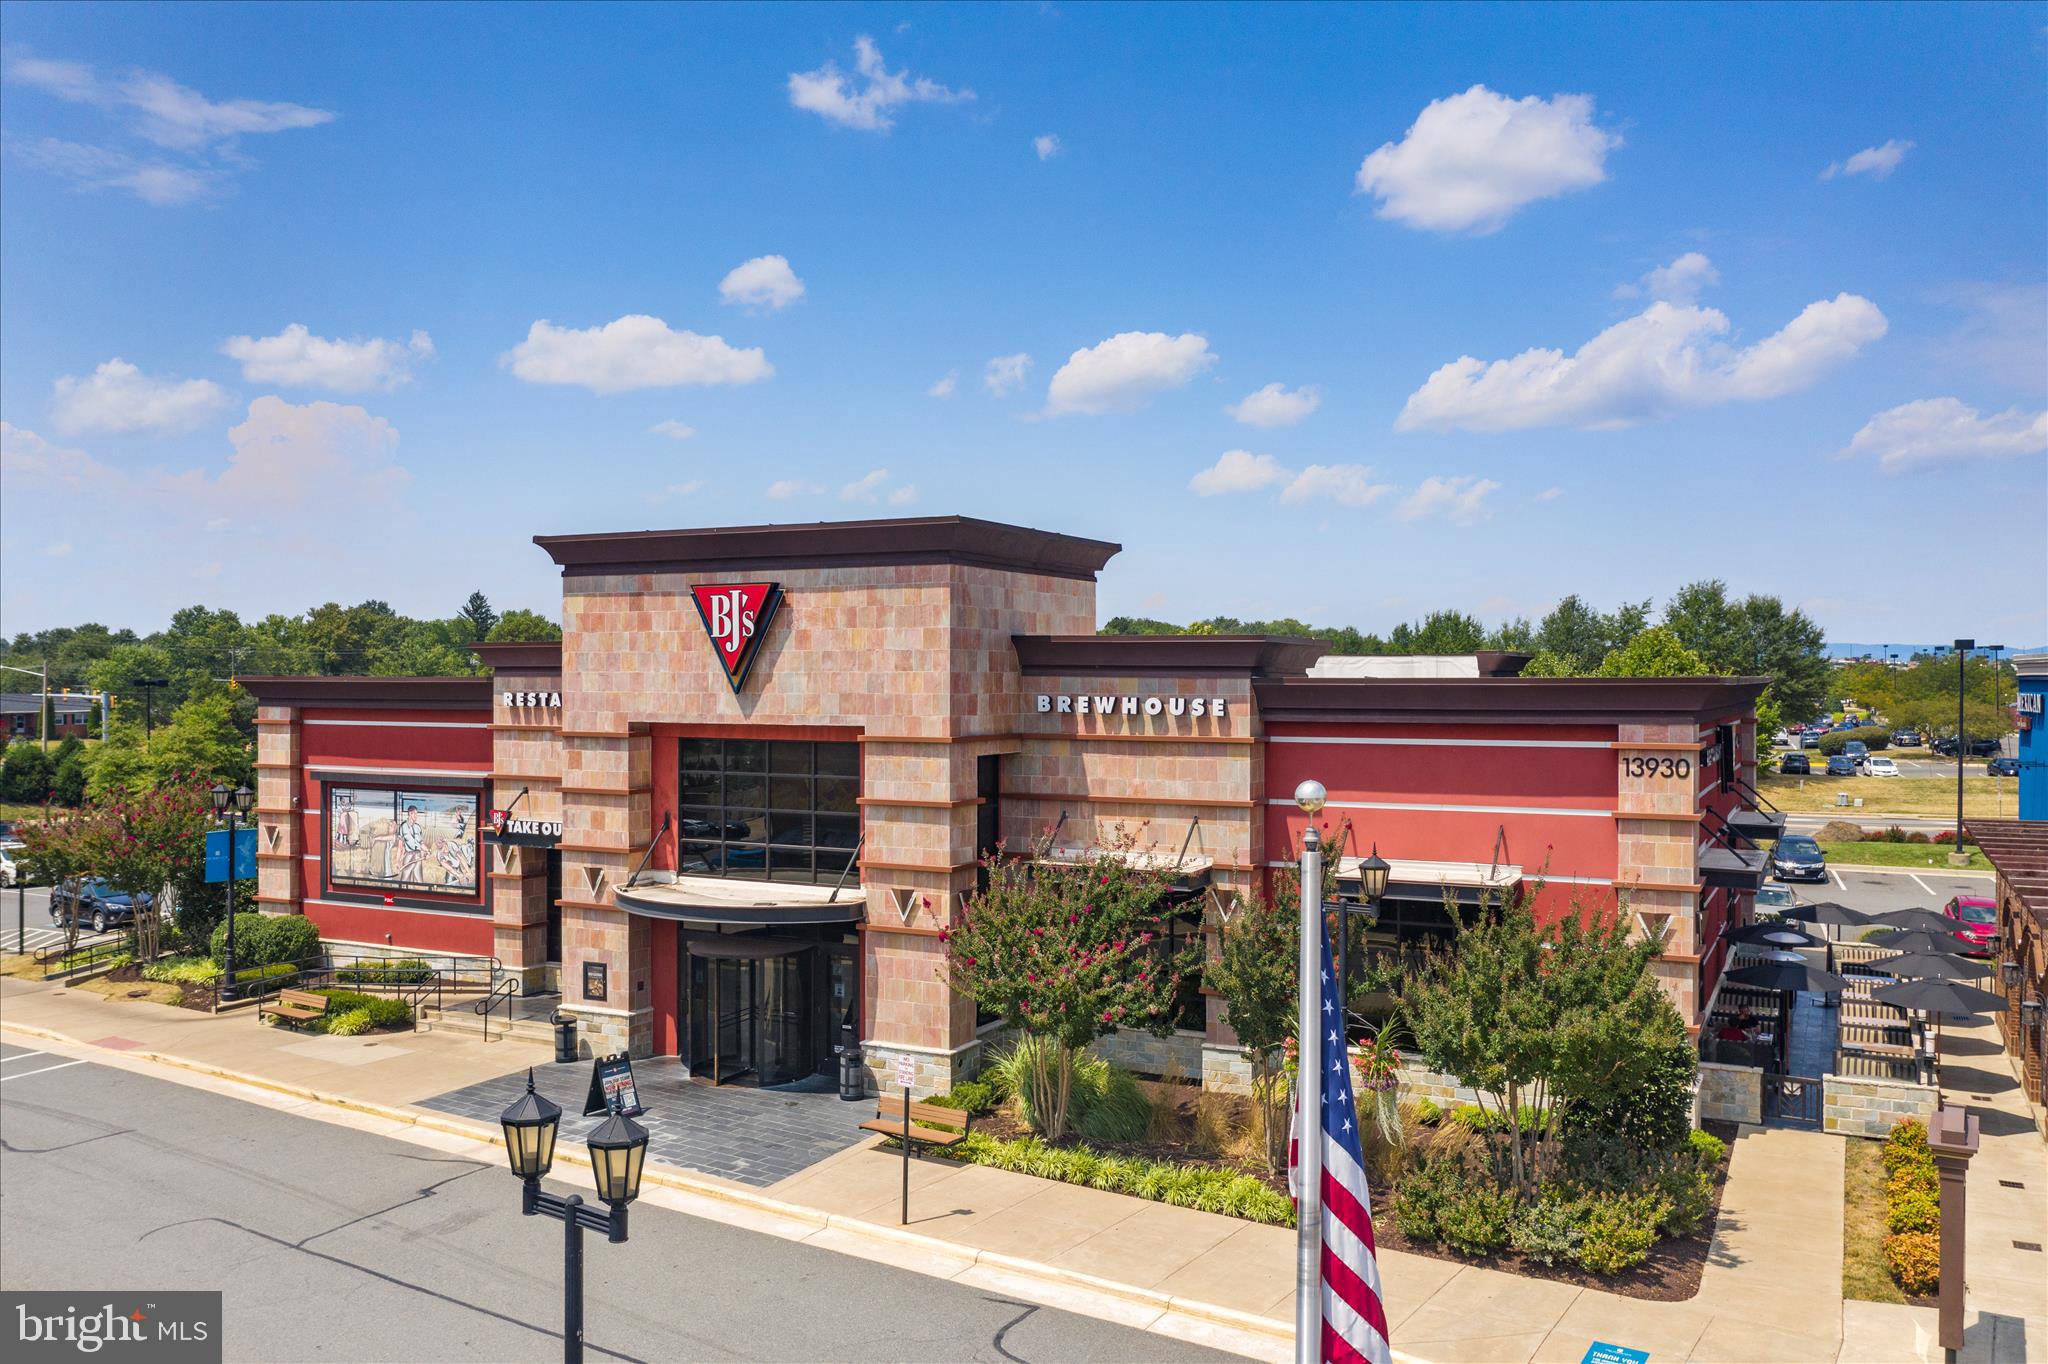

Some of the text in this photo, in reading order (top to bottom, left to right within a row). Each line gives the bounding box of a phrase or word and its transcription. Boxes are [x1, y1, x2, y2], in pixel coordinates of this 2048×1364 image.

[503, 692, 562, 707] RESTA
[1037, 695, 1225, 717] BREWHOUSE
[1622, 757, 1690, 779] 13930
[507, 820, 540, 834] TAKE
[1592, 1351, 1620, 1362] THANK
